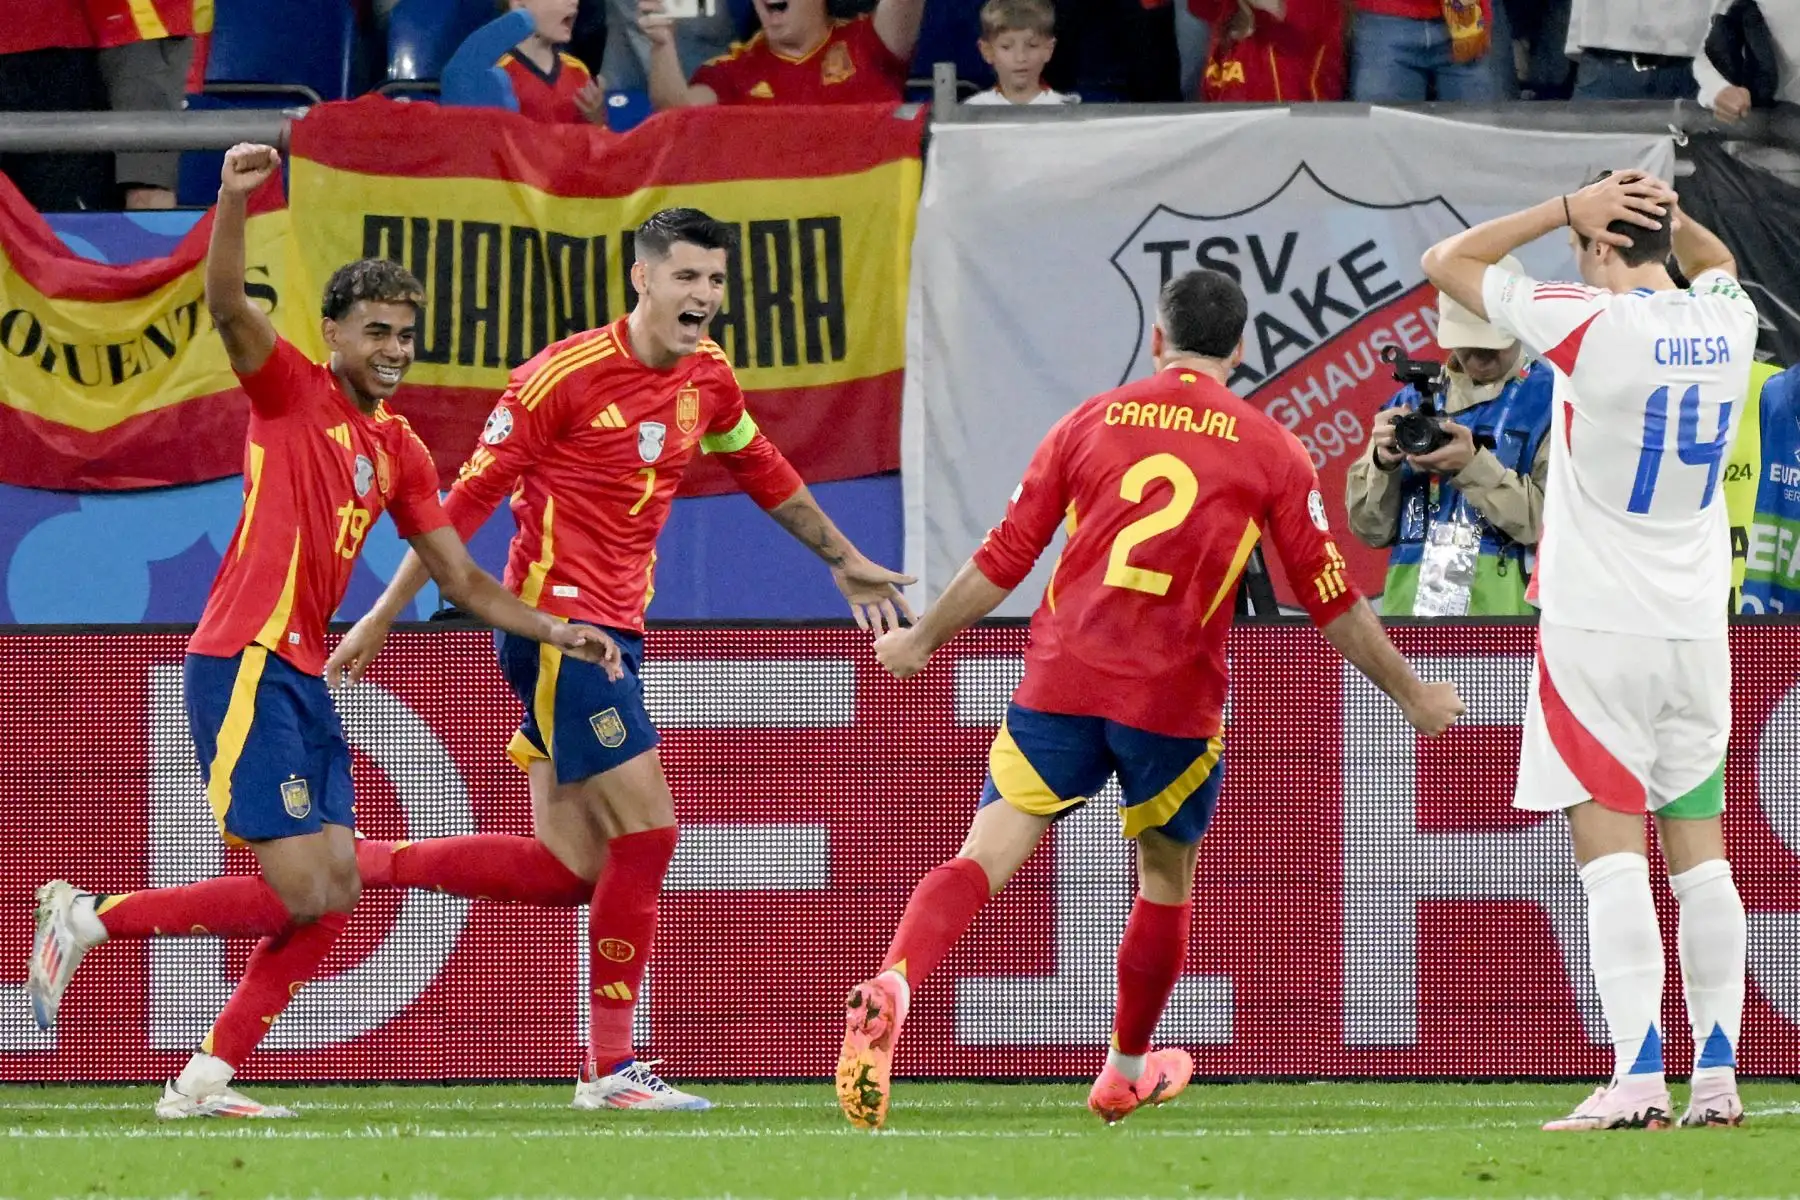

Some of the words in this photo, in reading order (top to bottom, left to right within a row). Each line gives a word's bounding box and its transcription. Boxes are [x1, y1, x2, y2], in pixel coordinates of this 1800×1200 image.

[1143, 231, 1298, 294] TSV
[1655, 336, 1730, 366] CHIESA
[1104, 401, 1240, 442] CARVAJAL
[1626, 384, 1733, 515] 14
[1723, 463, 1752, 482] 24
[638, 467, 657, 516] 7
[334, 499, 371, 559] 19
[1103, 452, 1199, 596] 2
